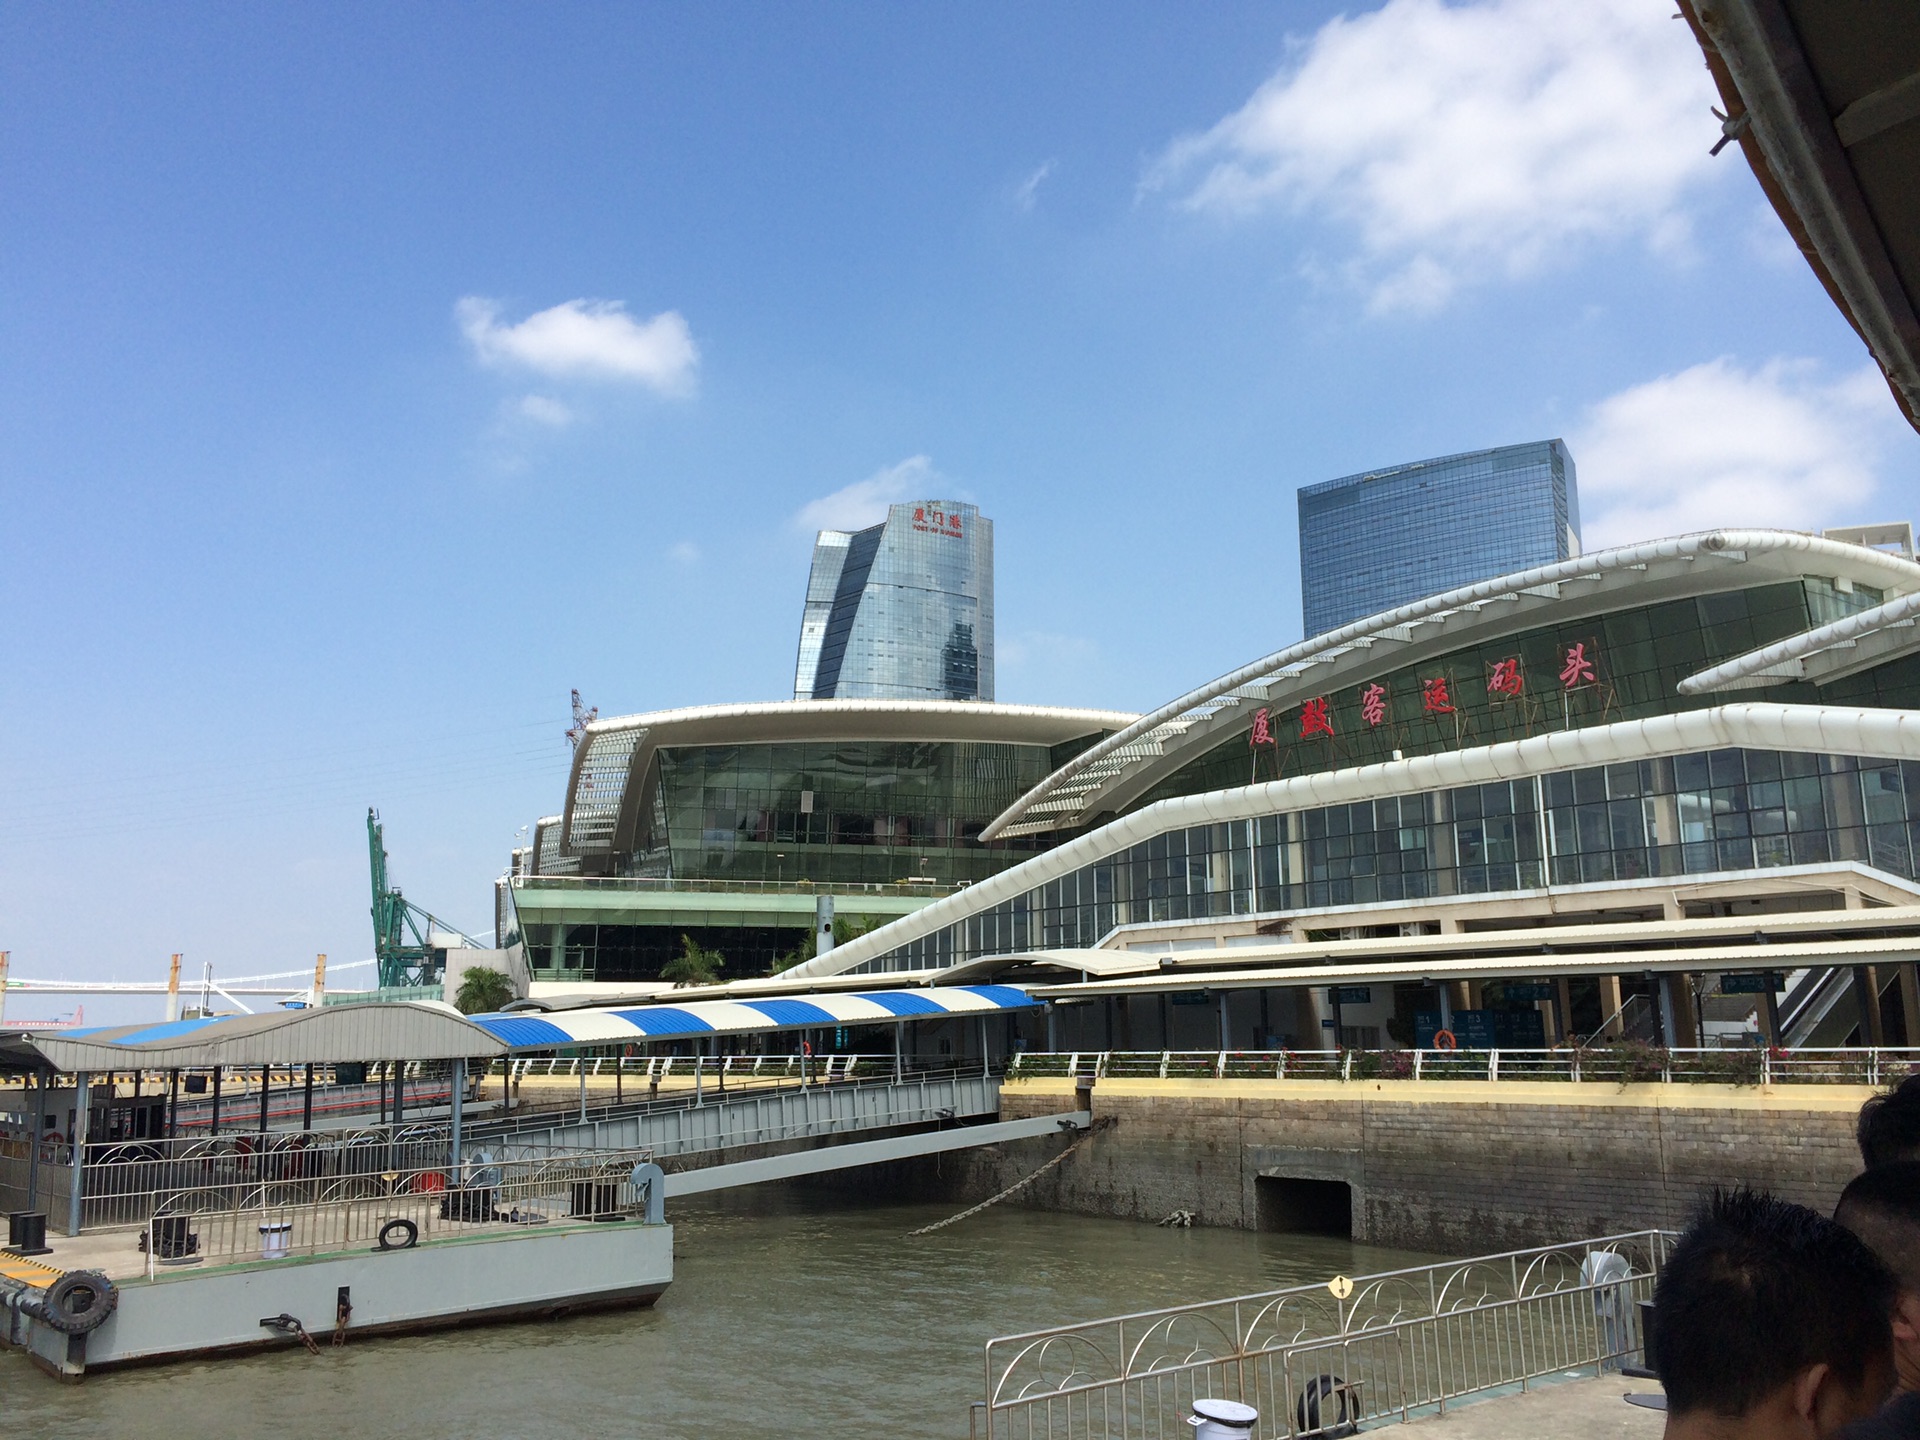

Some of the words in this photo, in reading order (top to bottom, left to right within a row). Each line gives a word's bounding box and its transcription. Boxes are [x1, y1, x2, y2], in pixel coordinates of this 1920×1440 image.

[1250, 643, 1595, 746] 厦鼓客运码头
